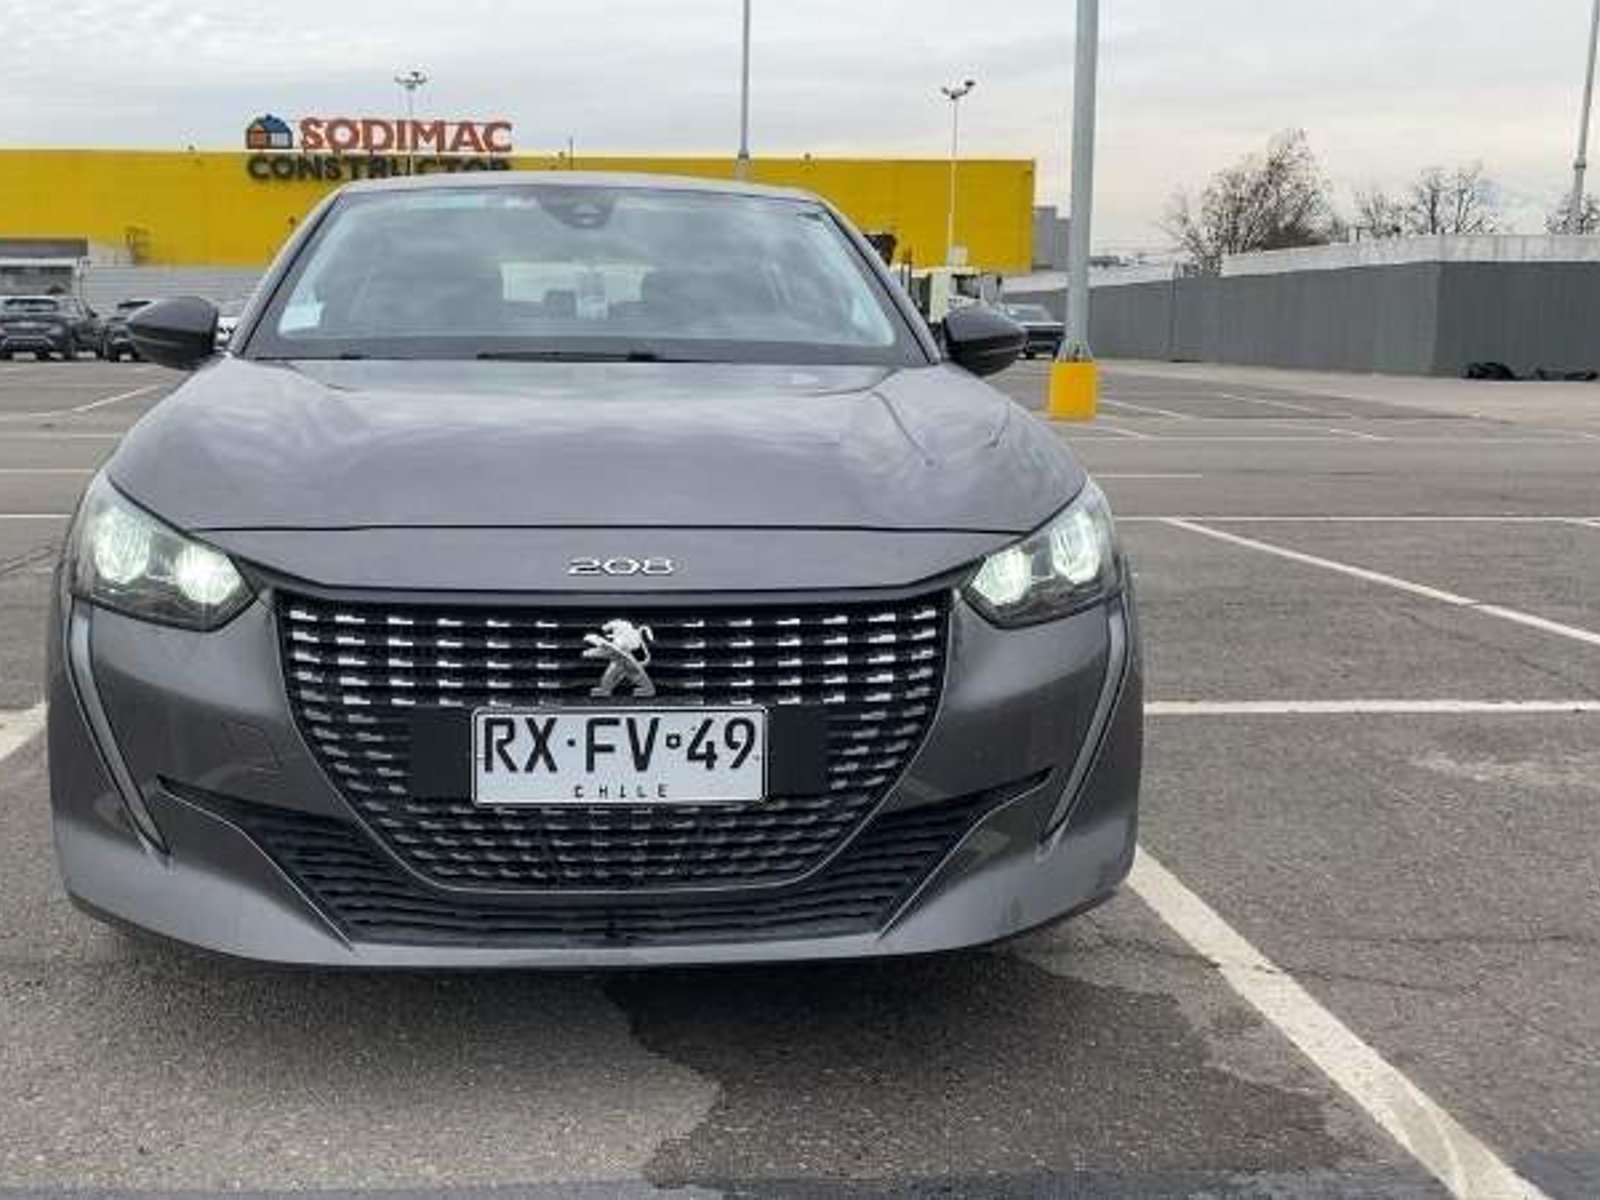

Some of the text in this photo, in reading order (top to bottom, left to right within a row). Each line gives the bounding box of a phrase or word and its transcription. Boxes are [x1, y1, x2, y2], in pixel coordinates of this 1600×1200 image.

[301, 118, 512, 152] SODIMAC
[567, 558, 674, 576] 208
[574, 785, 669, 799] CHILE
